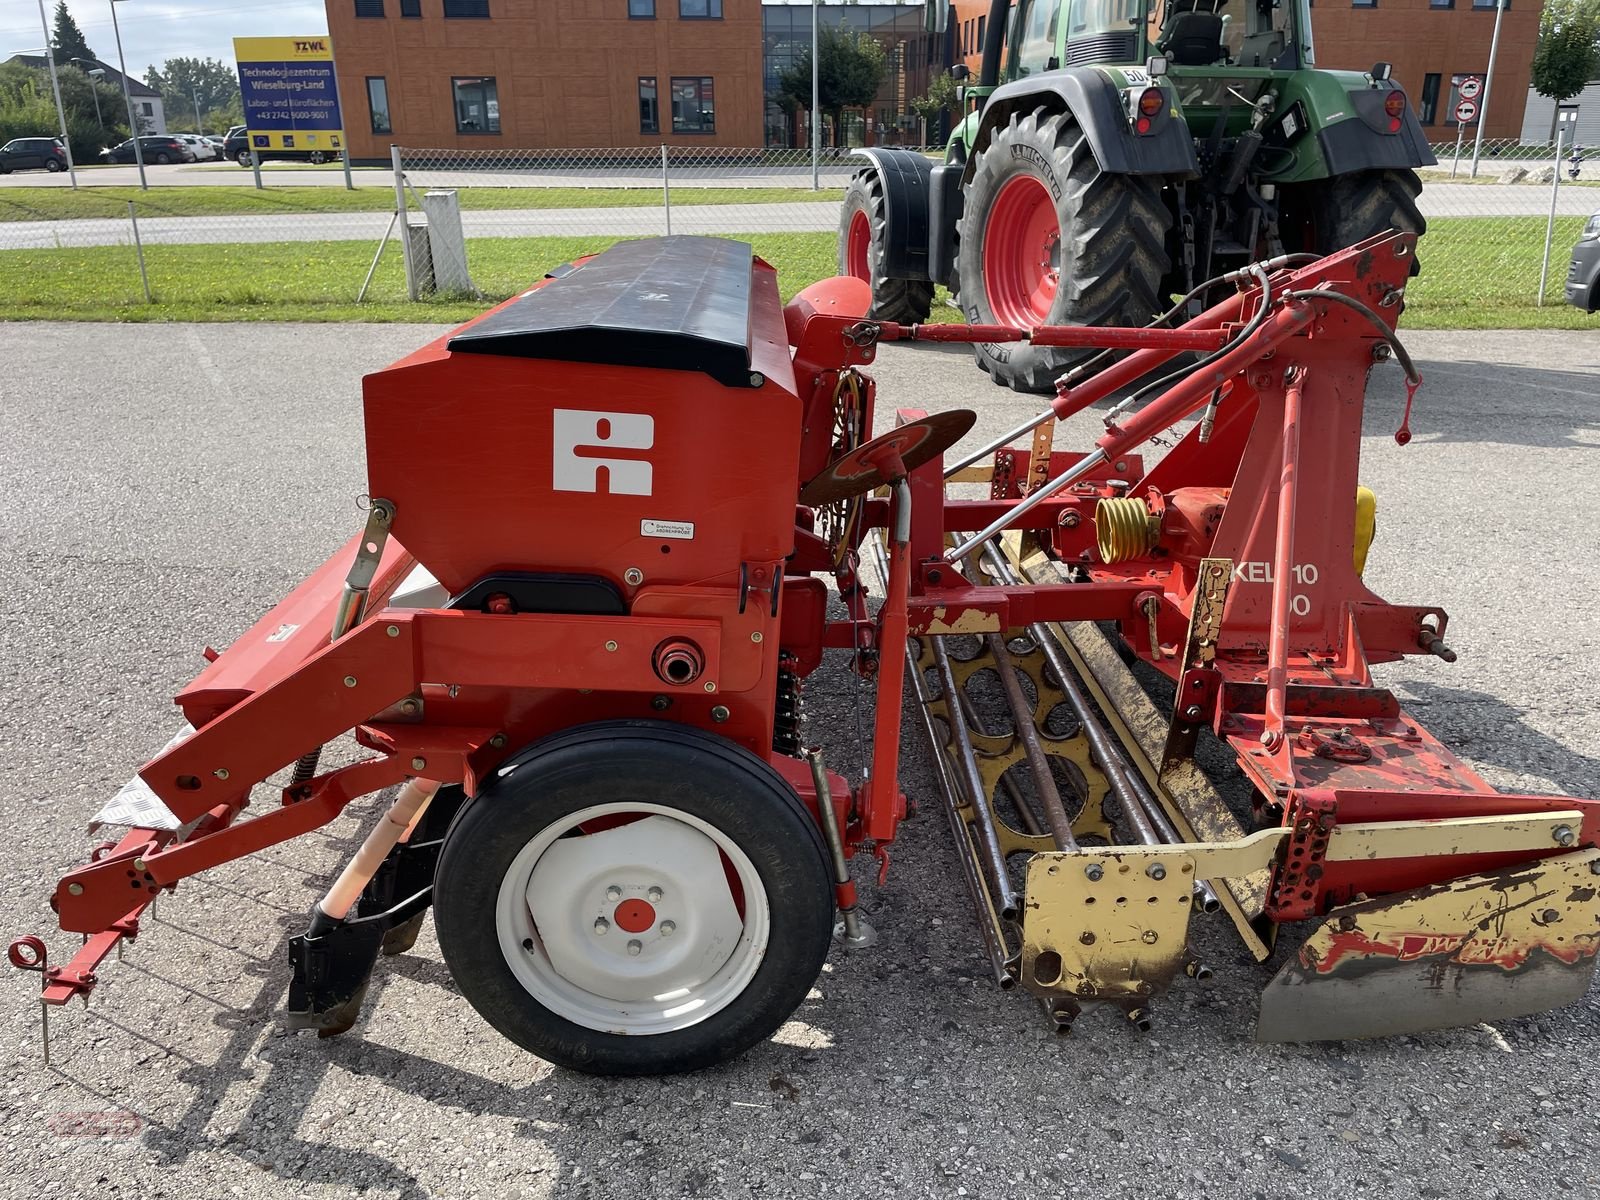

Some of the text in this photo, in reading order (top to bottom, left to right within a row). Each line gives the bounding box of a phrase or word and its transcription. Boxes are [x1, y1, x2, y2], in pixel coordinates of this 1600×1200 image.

[295, 41, 326, 51] TZWL
[242, 67, 330, 78] Technologiezentrum
[251, 80, 325, 91] Wieselburg-Land
[273, 99, 288, 107] und
[256, 111, 270, 119] +43
[271, 111, 290, 119] 2742
[1022, 146, 1061, 200] MICHELIN
